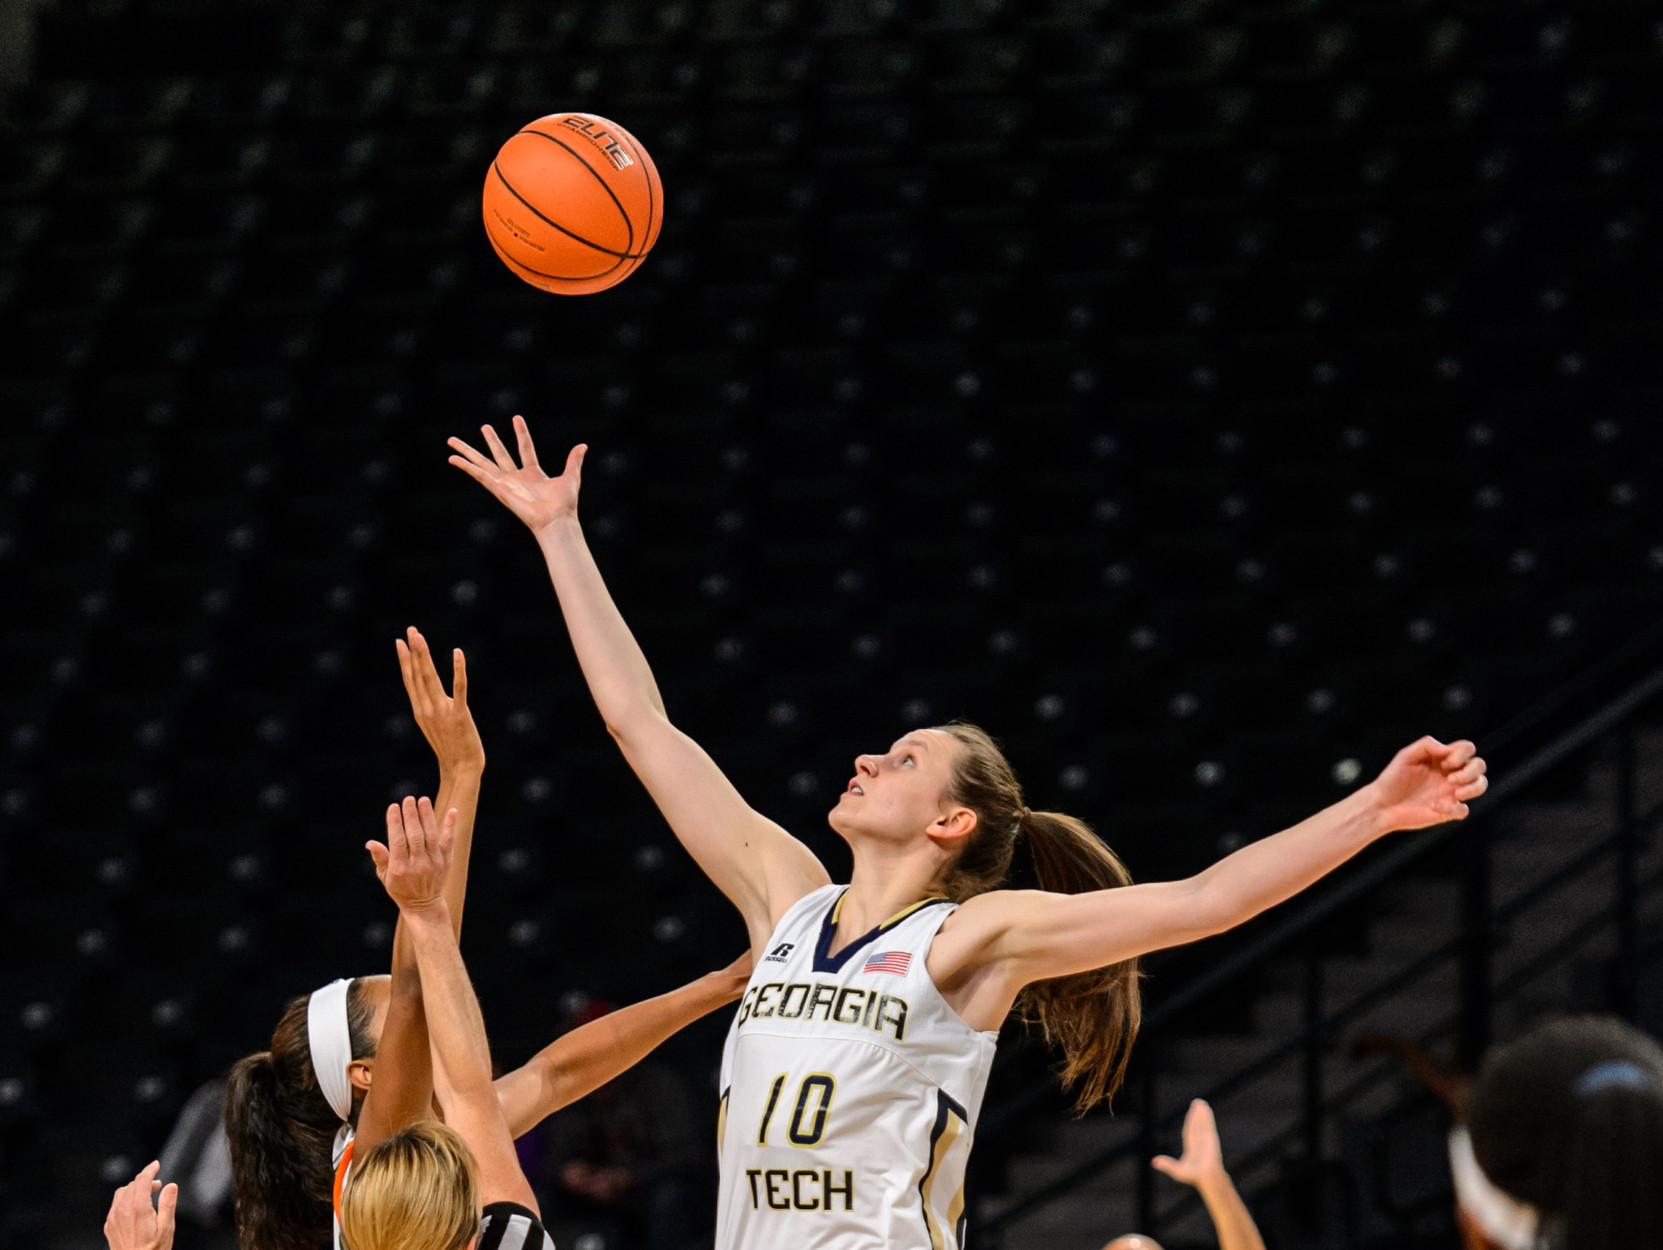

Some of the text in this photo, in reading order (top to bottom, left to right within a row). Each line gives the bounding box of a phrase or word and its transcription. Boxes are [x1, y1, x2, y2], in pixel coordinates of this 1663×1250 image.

[562, 115, 634, 170] ELITE
[738, 982, 909, 1041] GEORGIA
[757, 1071, 837, 1149] 10
[746, 1168, 854, 1212] TECH
